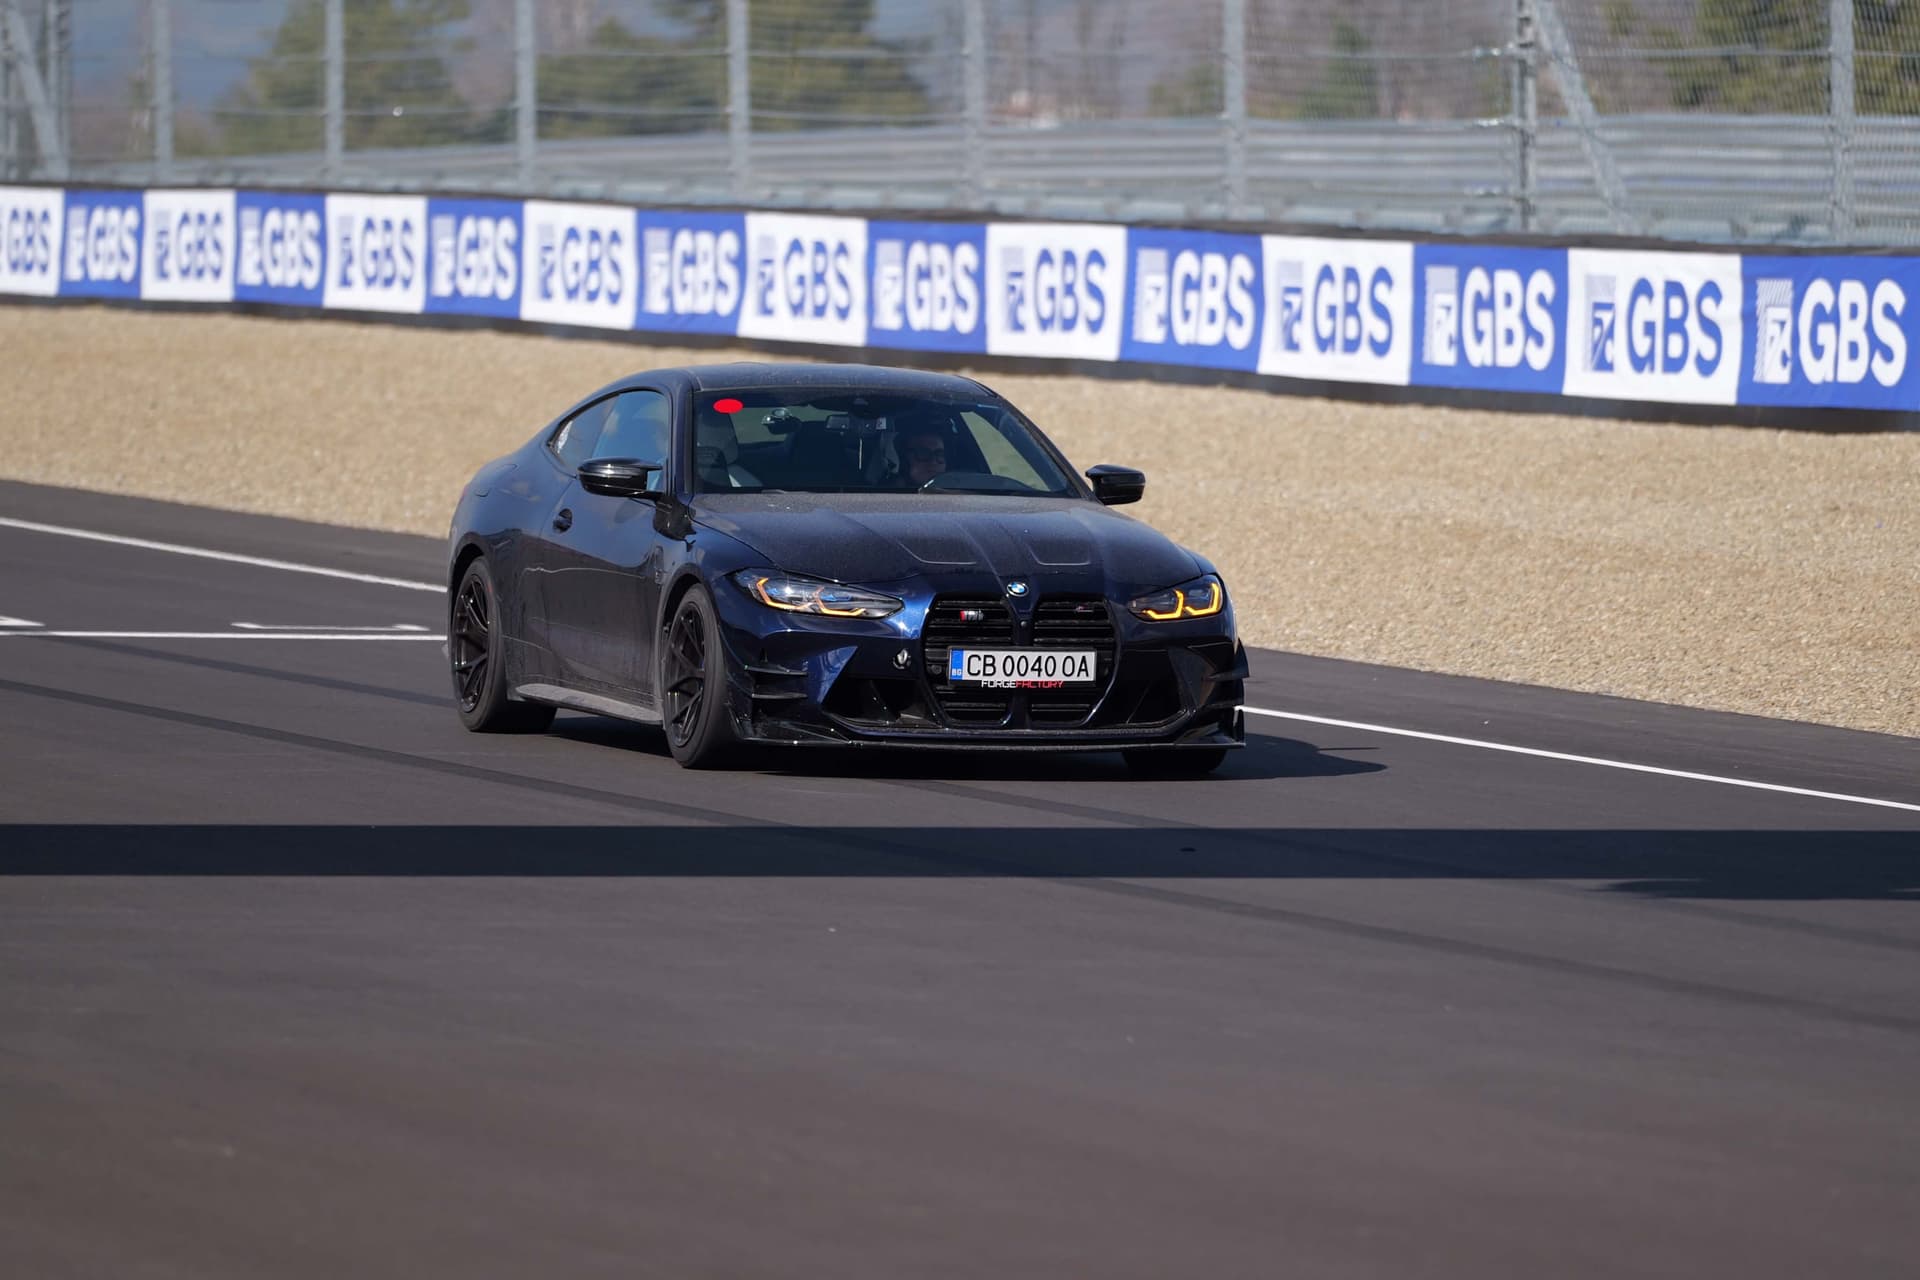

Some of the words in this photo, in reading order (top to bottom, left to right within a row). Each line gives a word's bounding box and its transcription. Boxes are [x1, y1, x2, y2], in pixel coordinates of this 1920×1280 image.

[6, 208, 51, 275] GBS
[87, 206, 139, 282] GBS
[177, 210, 224, 280] GBS
[261, 208, 322, 289] GBS
[361, 217, 415, 290] GBS
[456, 216, 518, 299] GBS
[561, 226, 623, 305] GBS
[671, 227, 740, 316] GBS
[784, 237, 851, 320] GBS
[906, 239, 979, 334] GBS
[1036, 248, 1107, 334] GBS
[1171, 250, 1257, 350] GBS
[1312, 264, 1394, 357] GBS
[1461, 266, 1556, 371] GBS
[1627, 278, 1723, 378] GBS
[1798, 278, 1907, 387] GBS
[951, 668, 962, 676] BG
[967, 654, 997, 677] CB
[1003, 655, 1057, 678] 0040
[1062, 655, 1089, 678] OA
